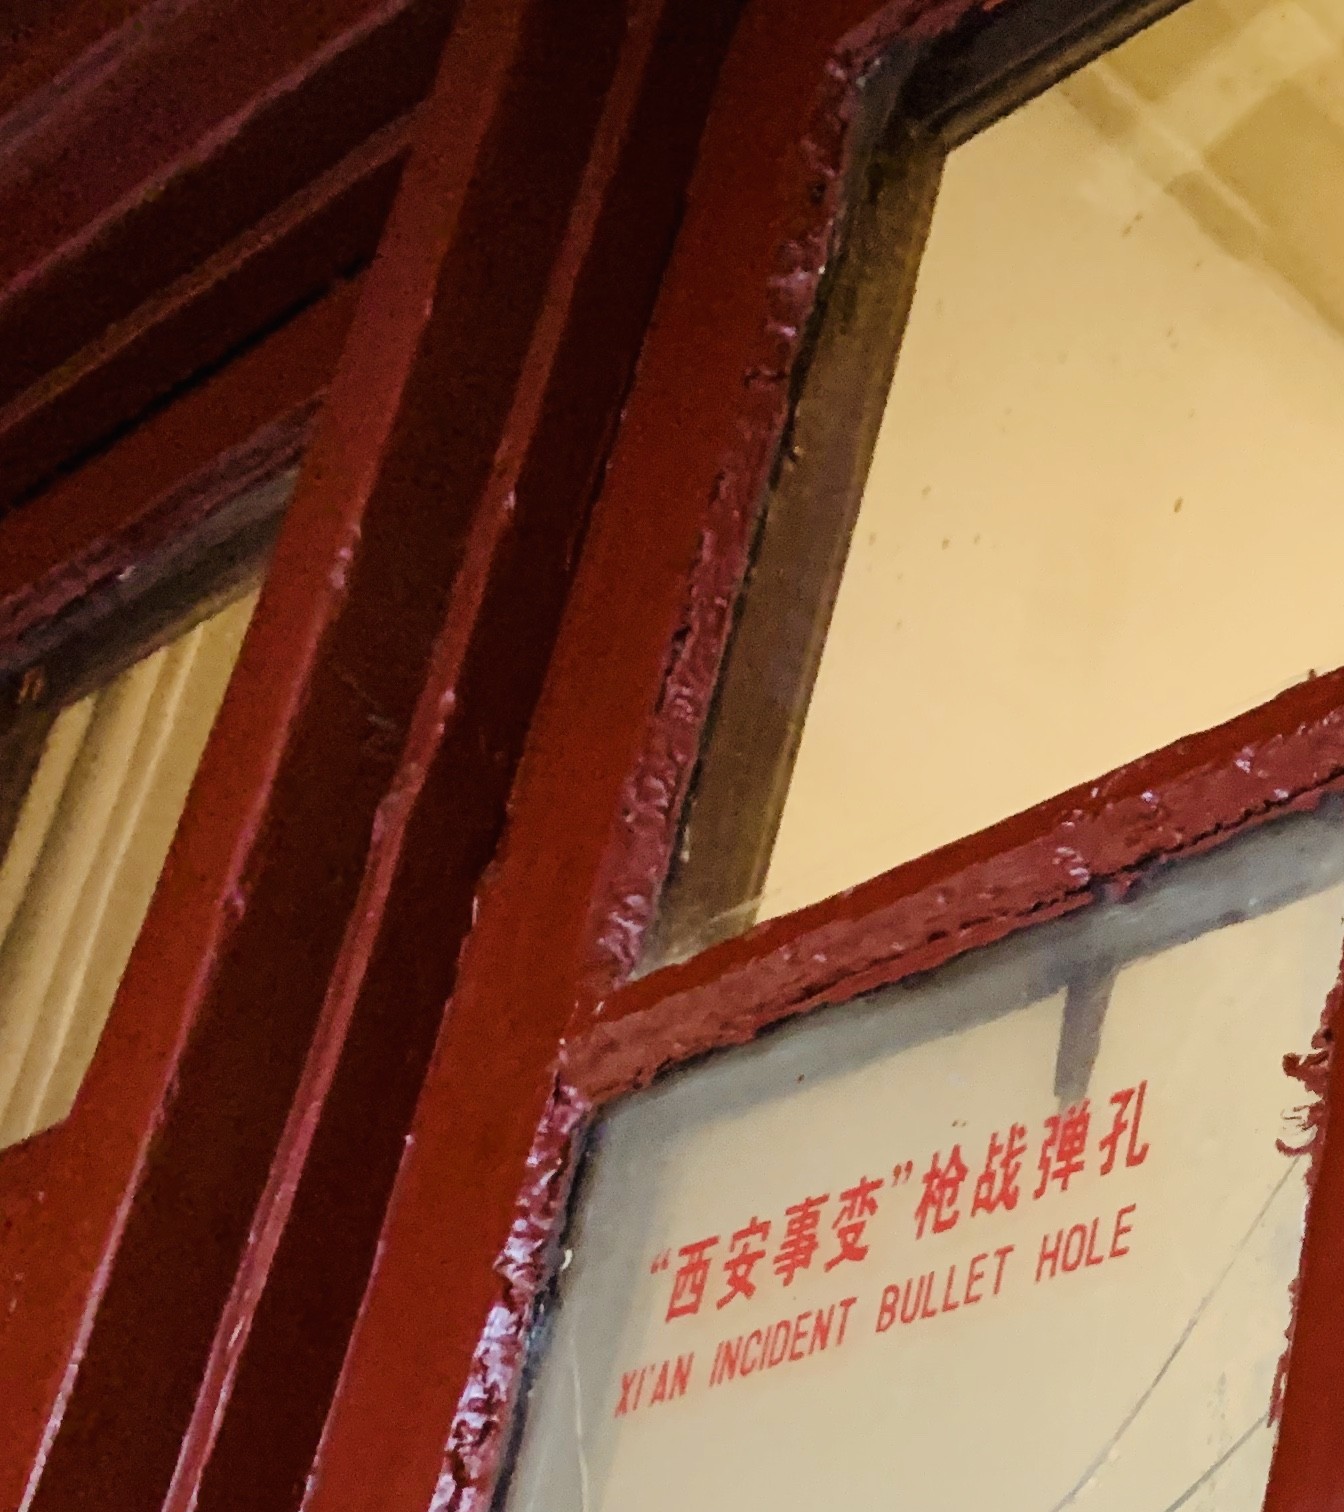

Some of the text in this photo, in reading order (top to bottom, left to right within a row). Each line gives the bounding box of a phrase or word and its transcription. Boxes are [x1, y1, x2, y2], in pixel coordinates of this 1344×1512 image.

[614, 1203, 1137, 1417] XI'AN INCIDENT BULLET HOLE
